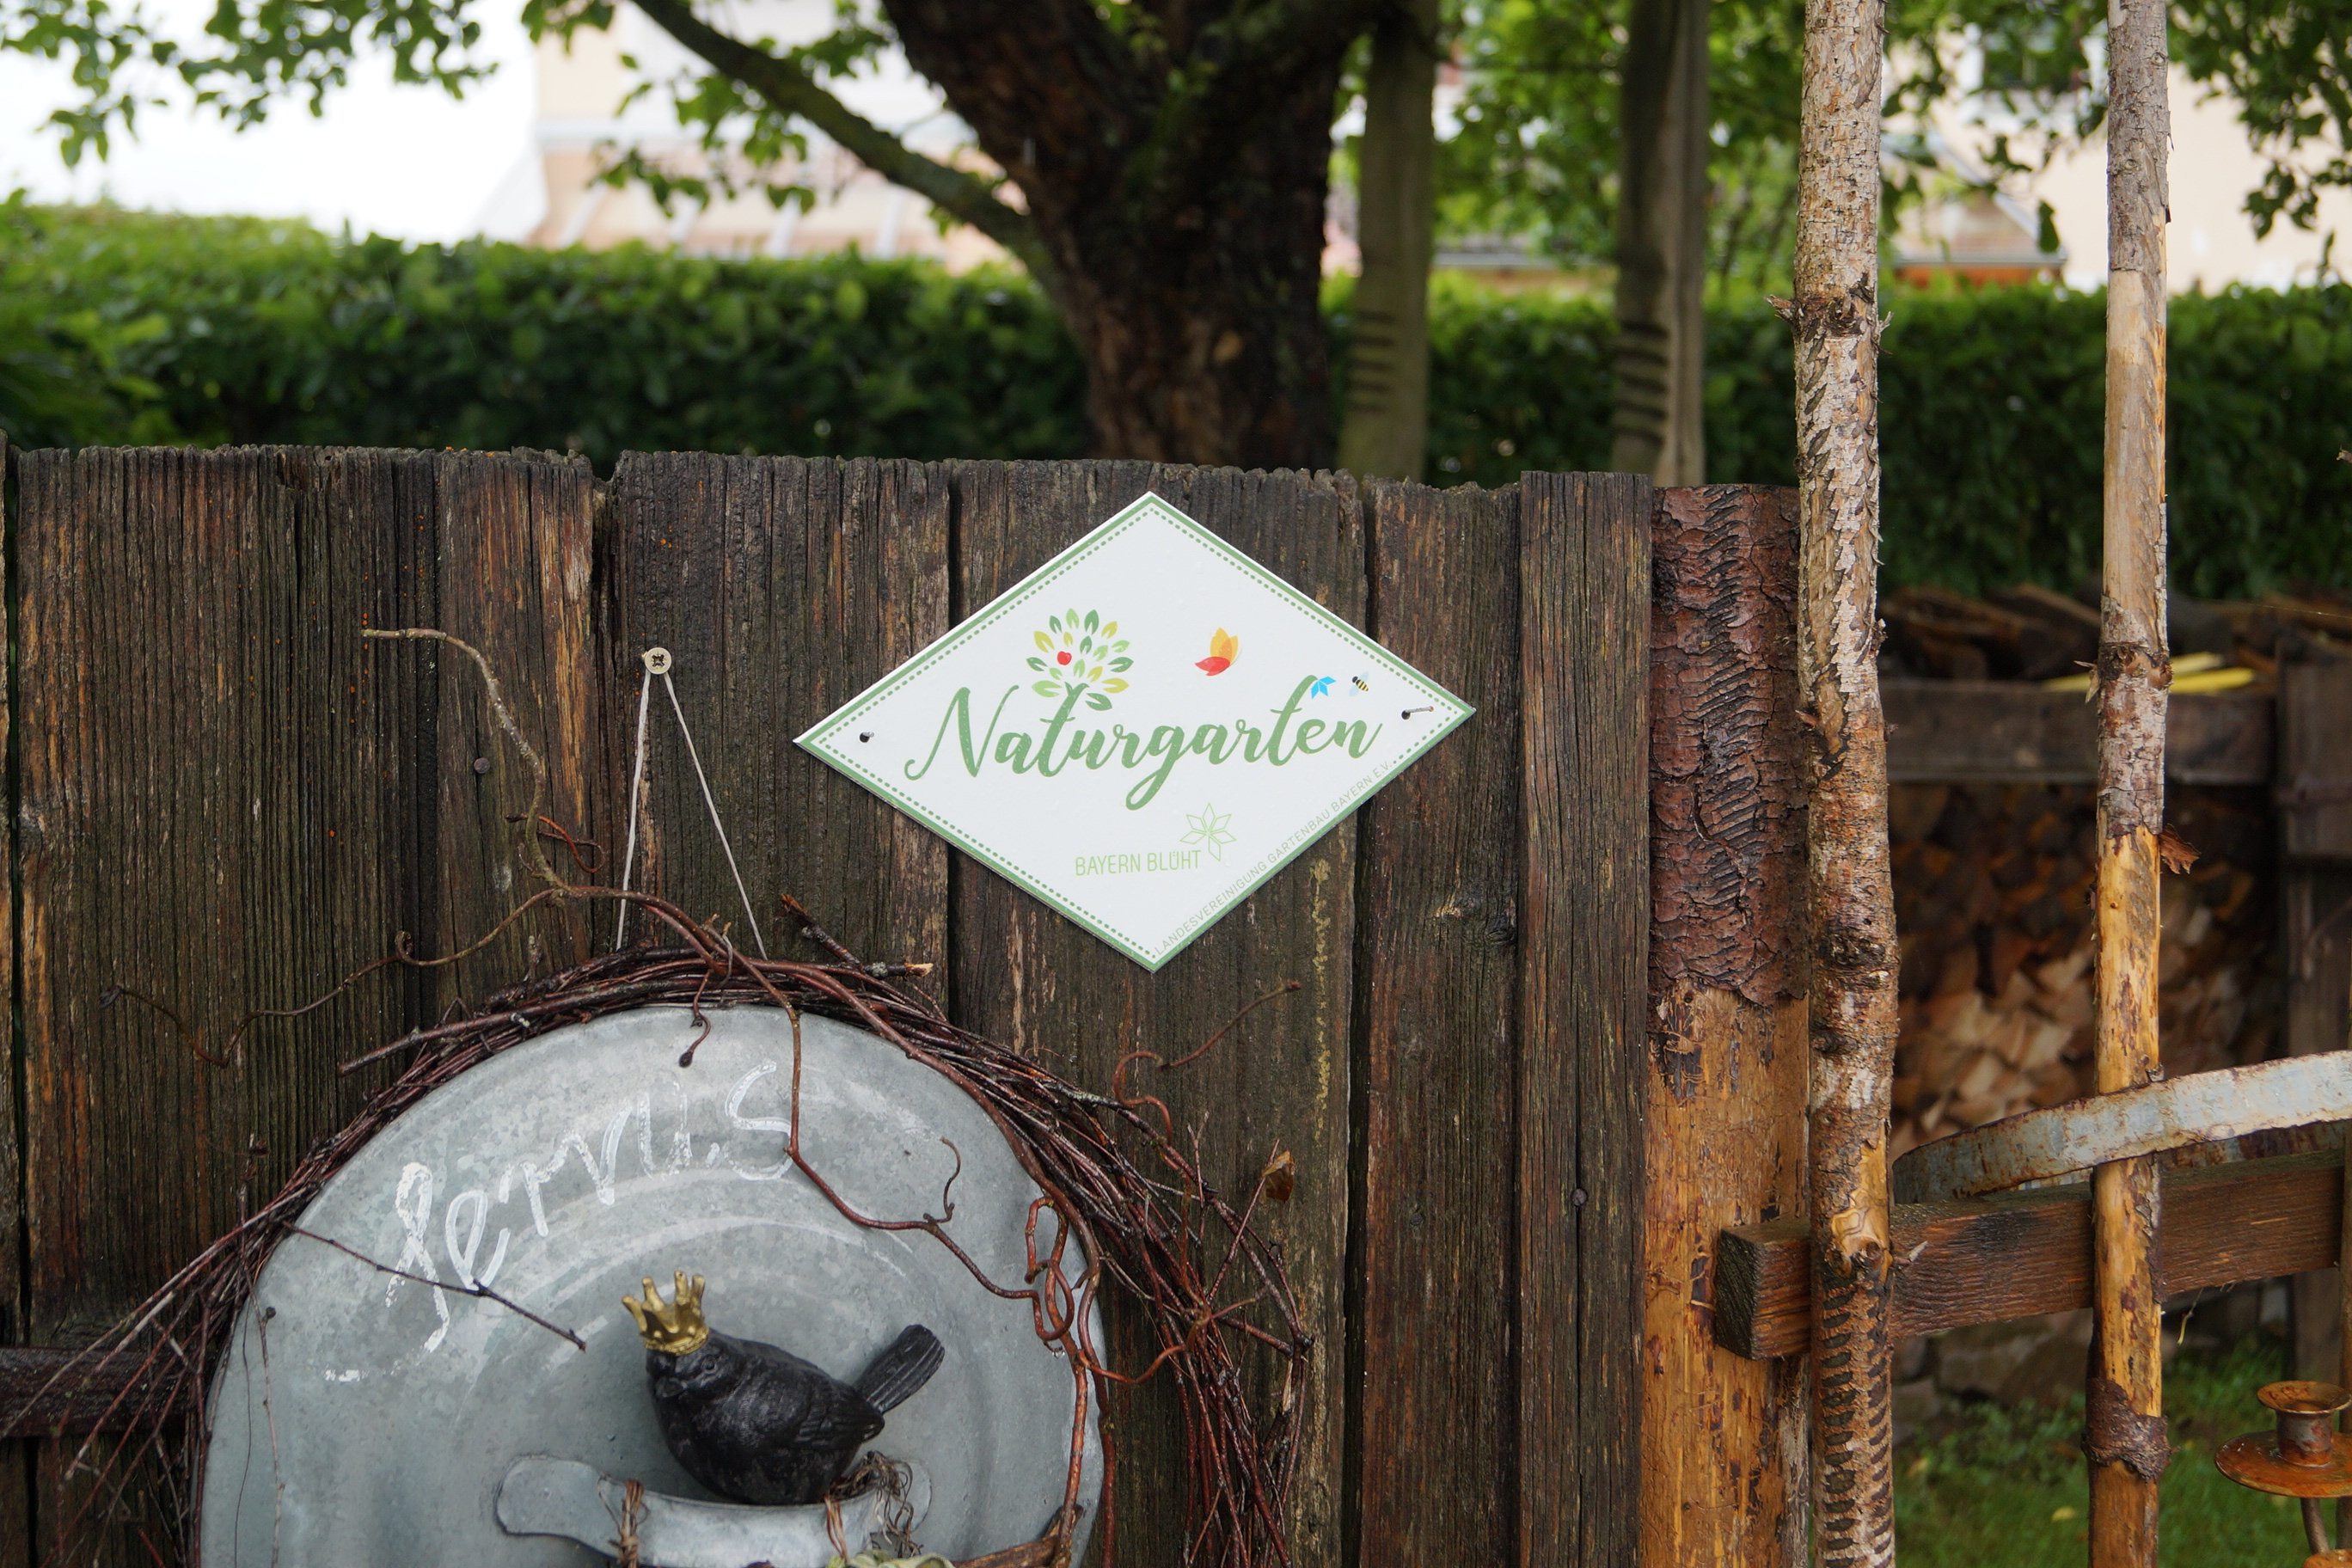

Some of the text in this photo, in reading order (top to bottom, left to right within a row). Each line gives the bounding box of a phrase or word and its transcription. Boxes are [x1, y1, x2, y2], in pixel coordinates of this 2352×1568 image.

[903, 675, 1383, 811] Naturgarten
[1075, 850, 1202, 876] BAYERN BLÜHT
[1155, 760, 1393, 955] LANDESVEREINIGUNG GARTENBAU BAYERN E.V.
